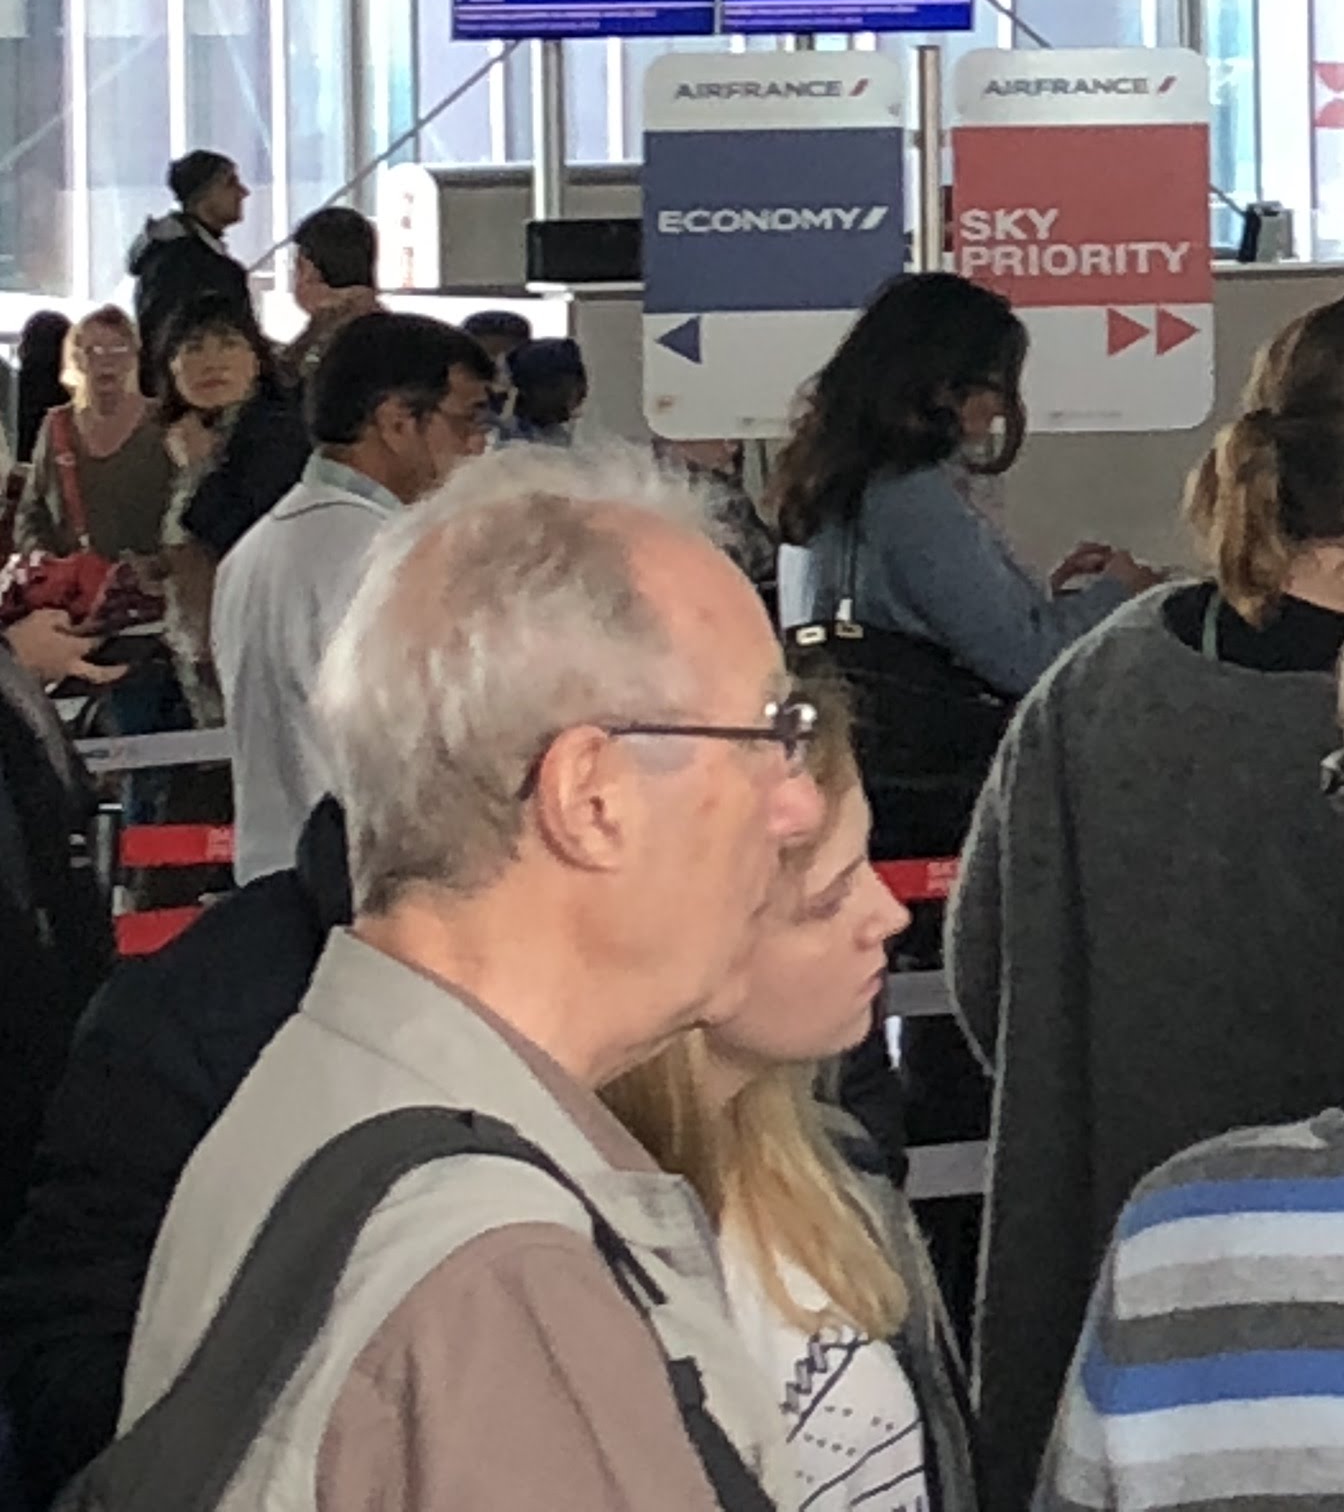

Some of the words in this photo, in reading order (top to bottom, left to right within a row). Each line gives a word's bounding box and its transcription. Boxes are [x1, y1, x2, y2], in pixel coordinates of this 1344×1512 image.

[675, 81, 843, 100] AIRFRANCE
[984, 77, 1149, 97] AIRFRANCE
[657, 207, 862, 234] ECONOMY
[960, 208, 1059, 241] SKY
[960, 241, 1191, 277] PRIORITY
